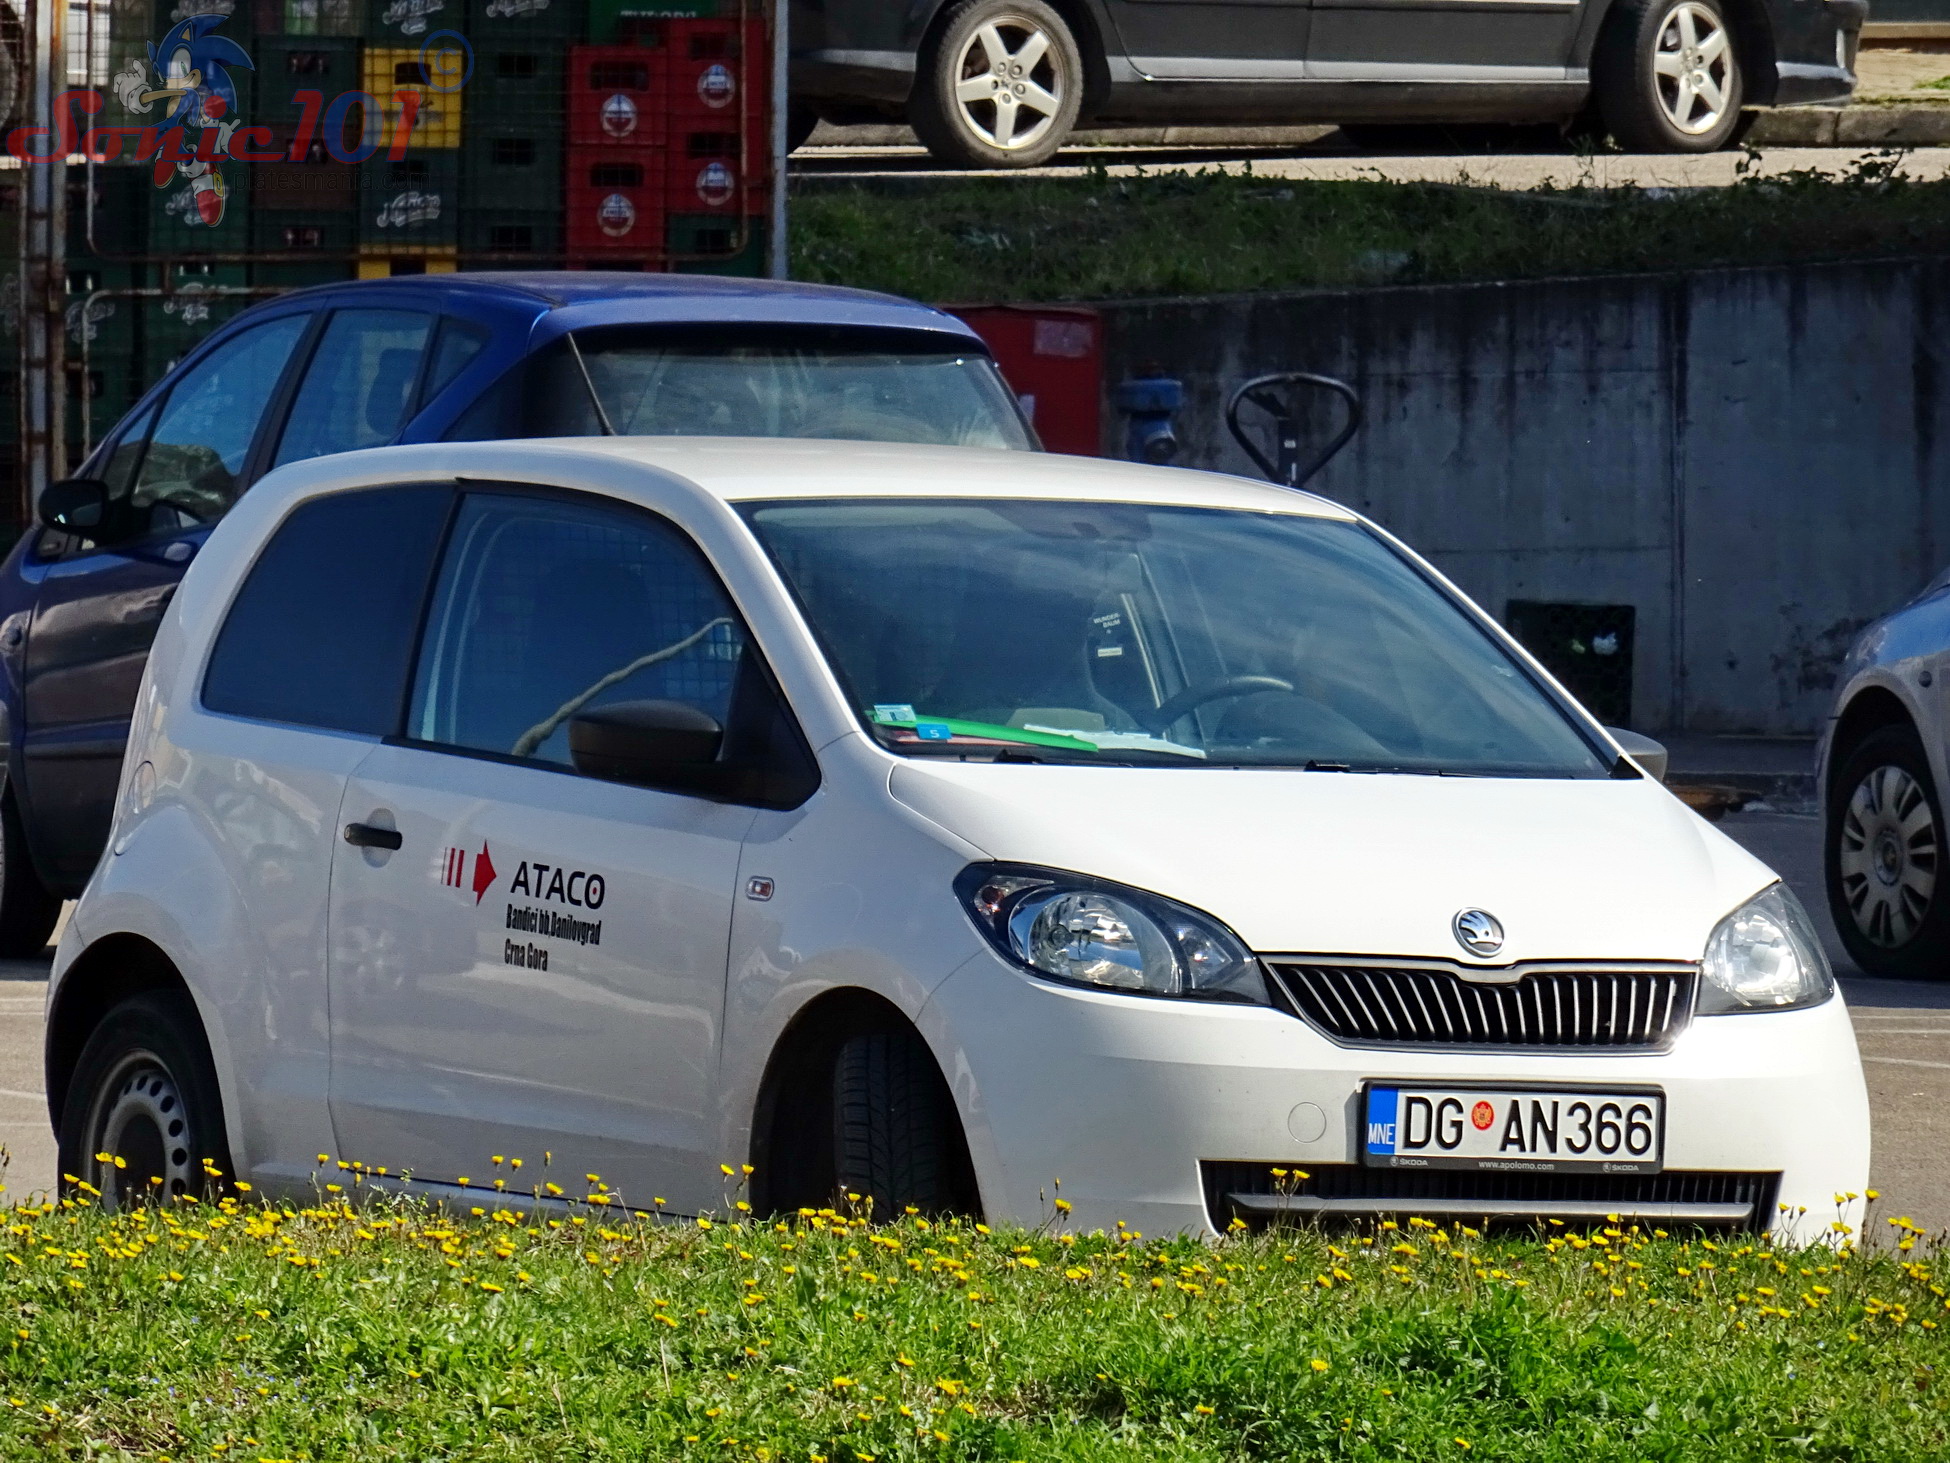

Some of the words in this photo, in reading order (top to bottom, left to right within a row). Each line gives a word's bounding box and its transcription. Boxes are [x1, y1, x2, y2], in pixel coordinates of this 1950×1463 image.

[510, 861, 605, 910] ATACO
[504, 938, 526, 967] Crna
[527, 942, 548, 971] Gora
[1368, 1123, 1395, 1145] MNE
[1402, 1096, 1464, 1150] DG
[1499, 1100, 1652, 1156] AN366
[1478, 1160, 1554, 1171] www.apolomo.com
